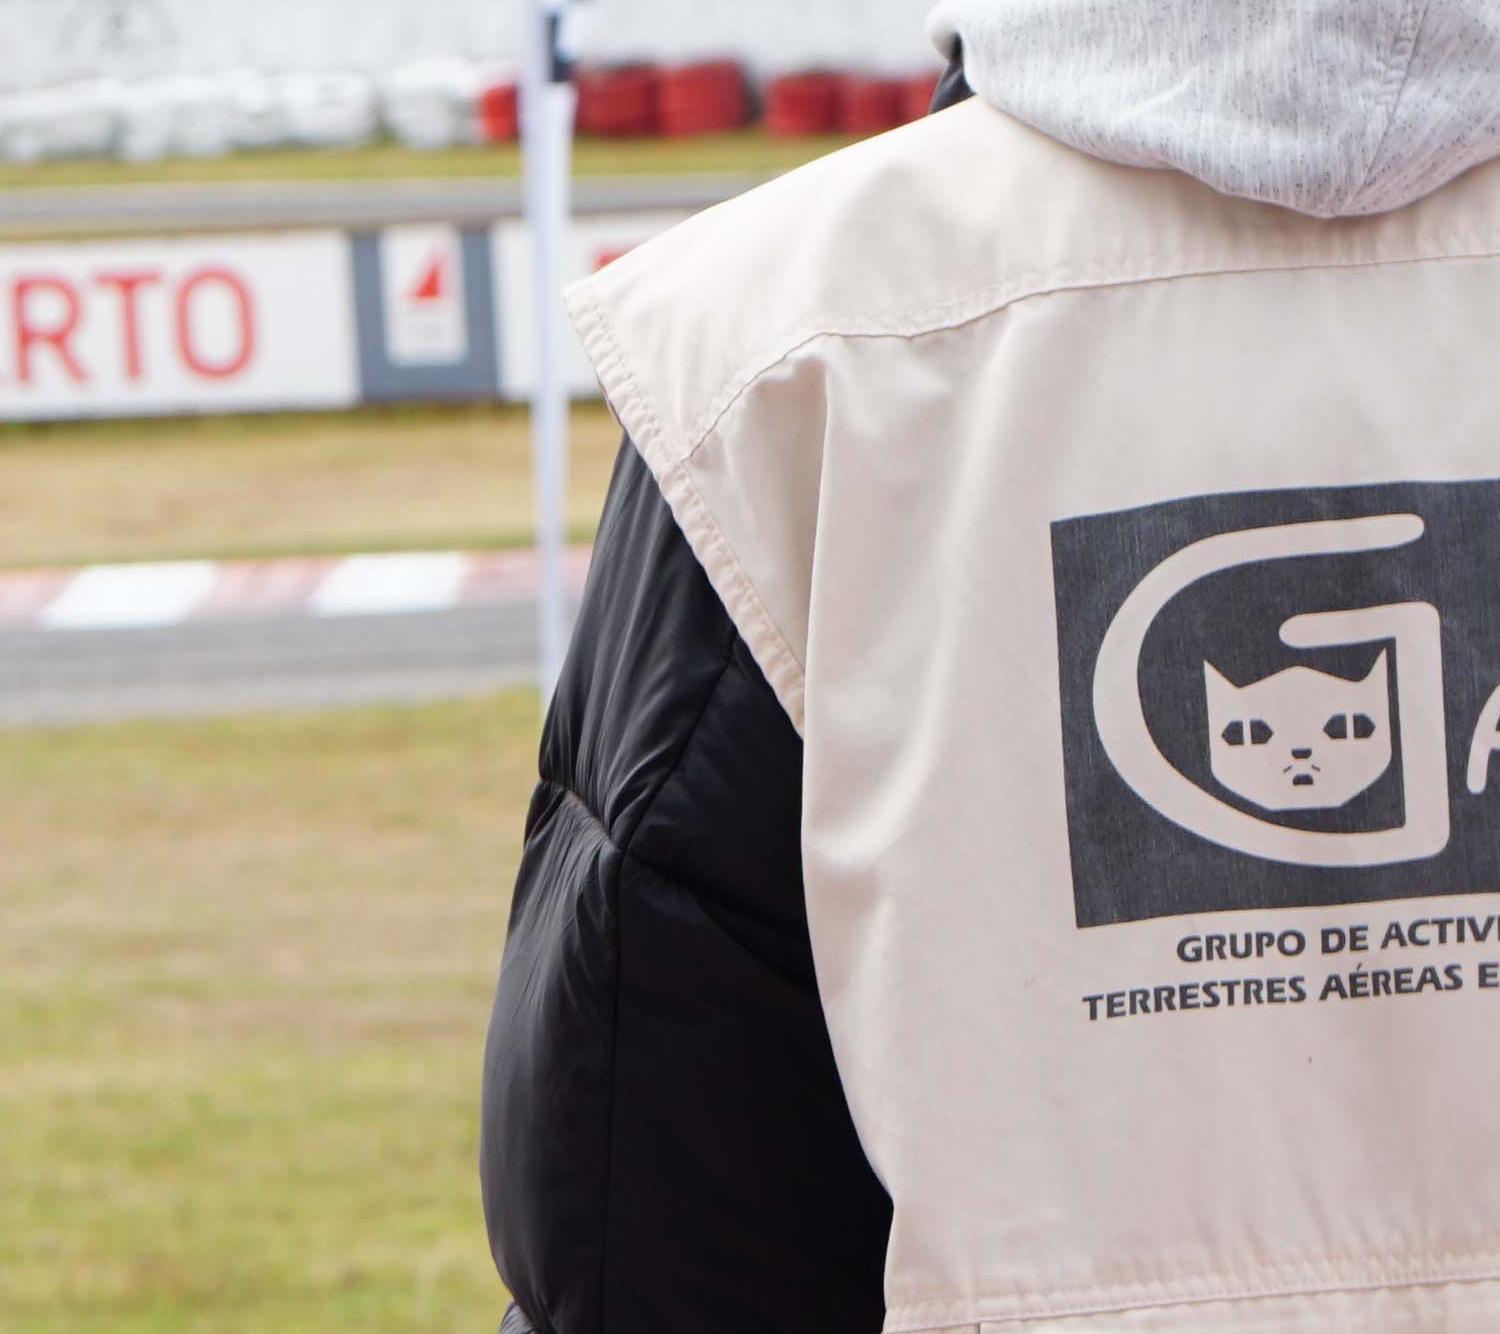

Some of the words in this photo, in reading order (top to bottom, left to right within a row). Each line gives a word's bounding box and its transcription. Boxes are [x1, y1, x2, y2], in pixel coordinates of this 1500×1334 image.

[1175, 929, 1307, 964] GRUPO
[1320, 924, 1370, 955] DE
[1081, 975, 1307, 1022] TERRESTRES
[1318, 963, 1464, 1003] AÉREAS
[1477, 962, 1500, 989] E
